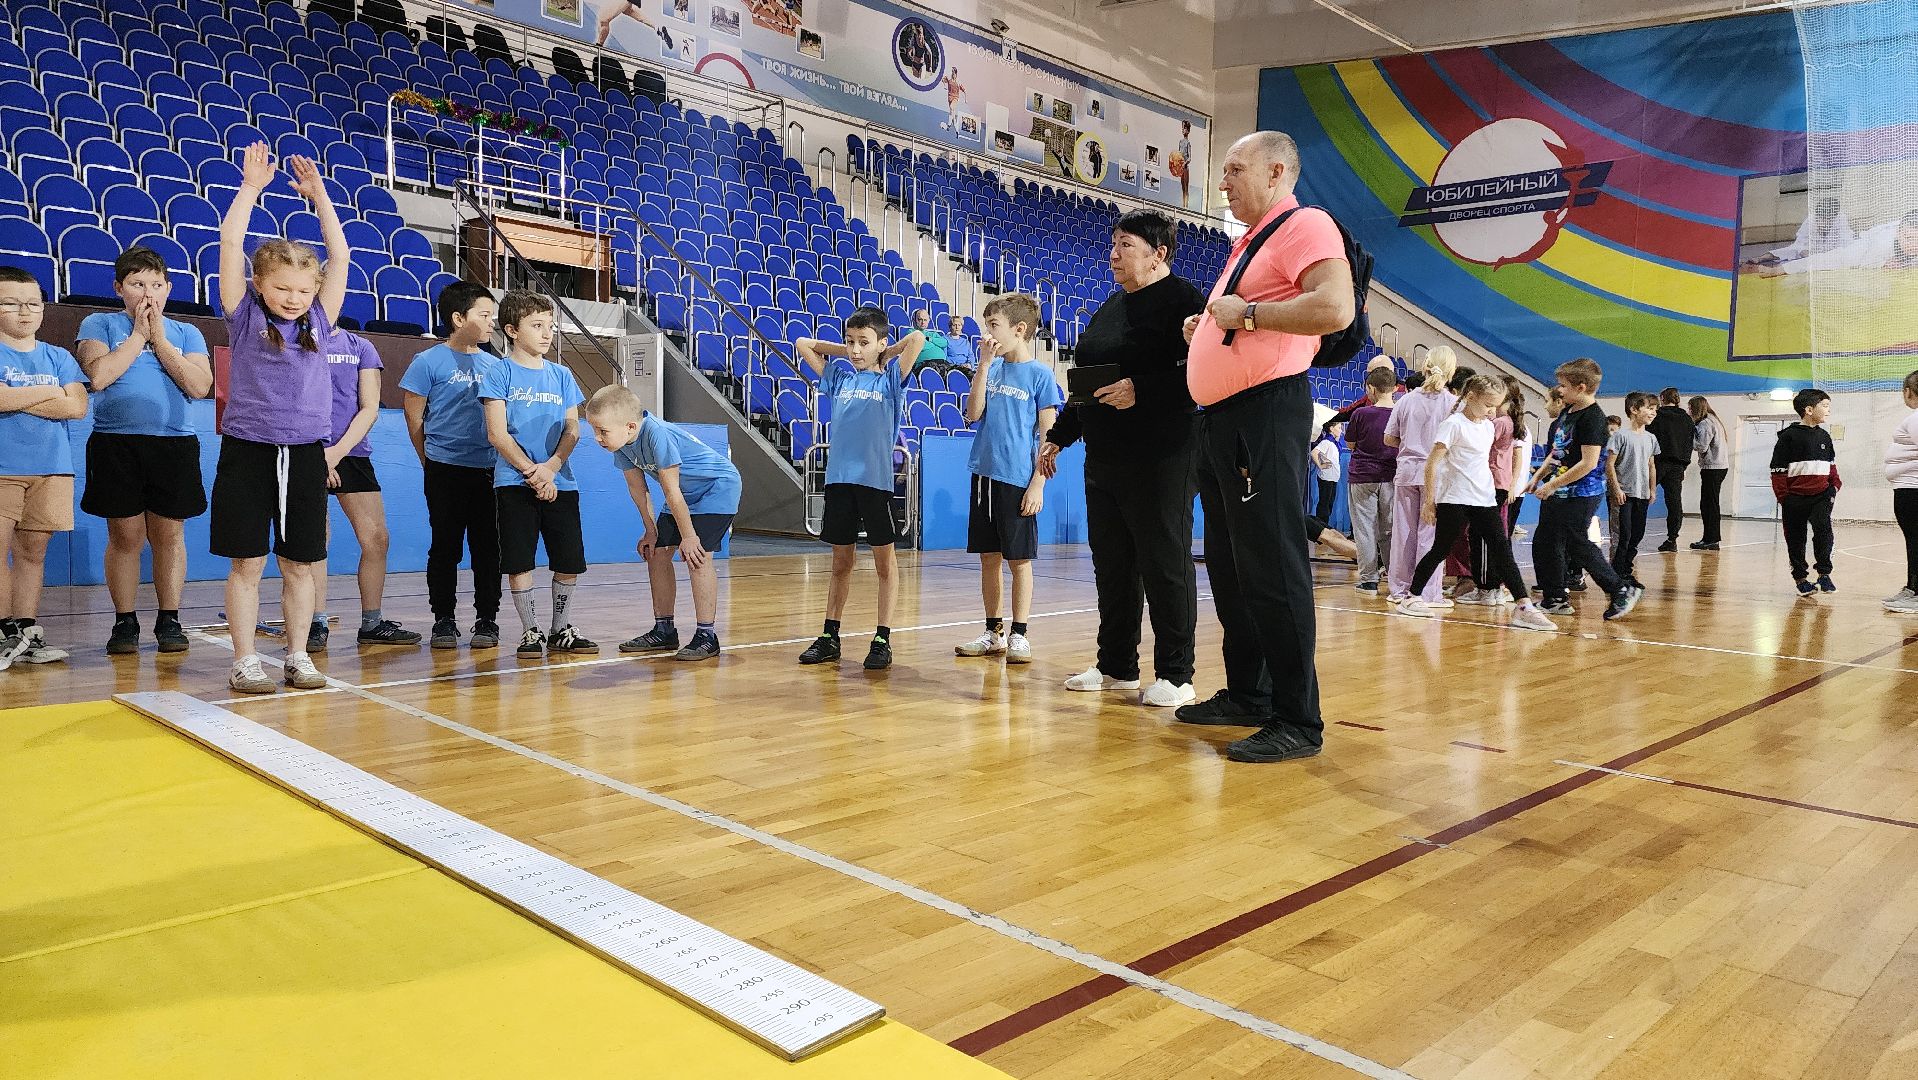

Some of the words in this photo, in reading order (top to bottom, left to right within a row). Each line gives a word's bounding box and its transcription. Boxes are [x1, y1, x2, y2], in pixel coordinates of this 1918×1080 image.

[761, 57, 787, 76] ТВОЯ
[839, 80, 865, 98] ТВОЙ
[1425, 171, 1558, 203] ЮБИЛЕЙНЫЙ
[1449, 208, 1491, 221] ДВОРЕЦ
[1492, 203, 1536, 215] СПОРТА
[516, 871, 543, 880] 220
[548, 885, 574, 895] 230
[578, 901, 606, 912] 240
[613, 918, 641, 930] 250
[650, 936, 679, 949] 260
[673, 946, 697, 958] 265
[690, 955, 720, 969] 270
[714, 967, 739, 979] 275
[734, 976, 763, 990] 280
[779, 999, 811, 1015] 290
[808, 1012, 834, 1026] 295
